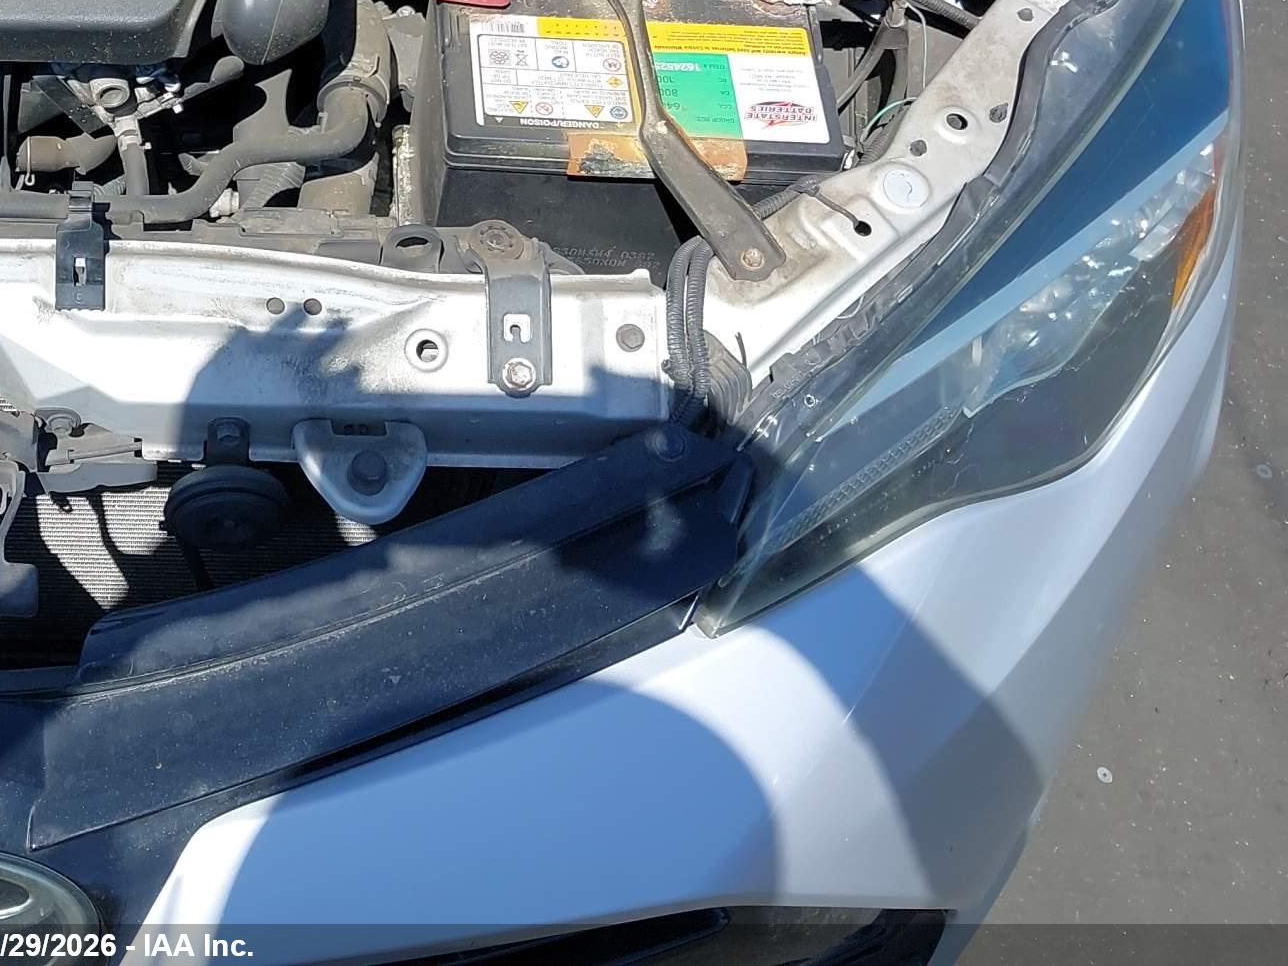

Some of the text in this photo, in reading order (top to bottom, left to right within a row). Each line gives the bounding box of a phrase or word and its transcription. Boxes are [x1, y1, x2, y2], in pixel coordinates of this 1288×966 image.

[749, 105, 813, 114] BATTERIES
[744, 112, 817, 122] INTERSTATE
[520, 118, 600, 129] DANGER/POISON
